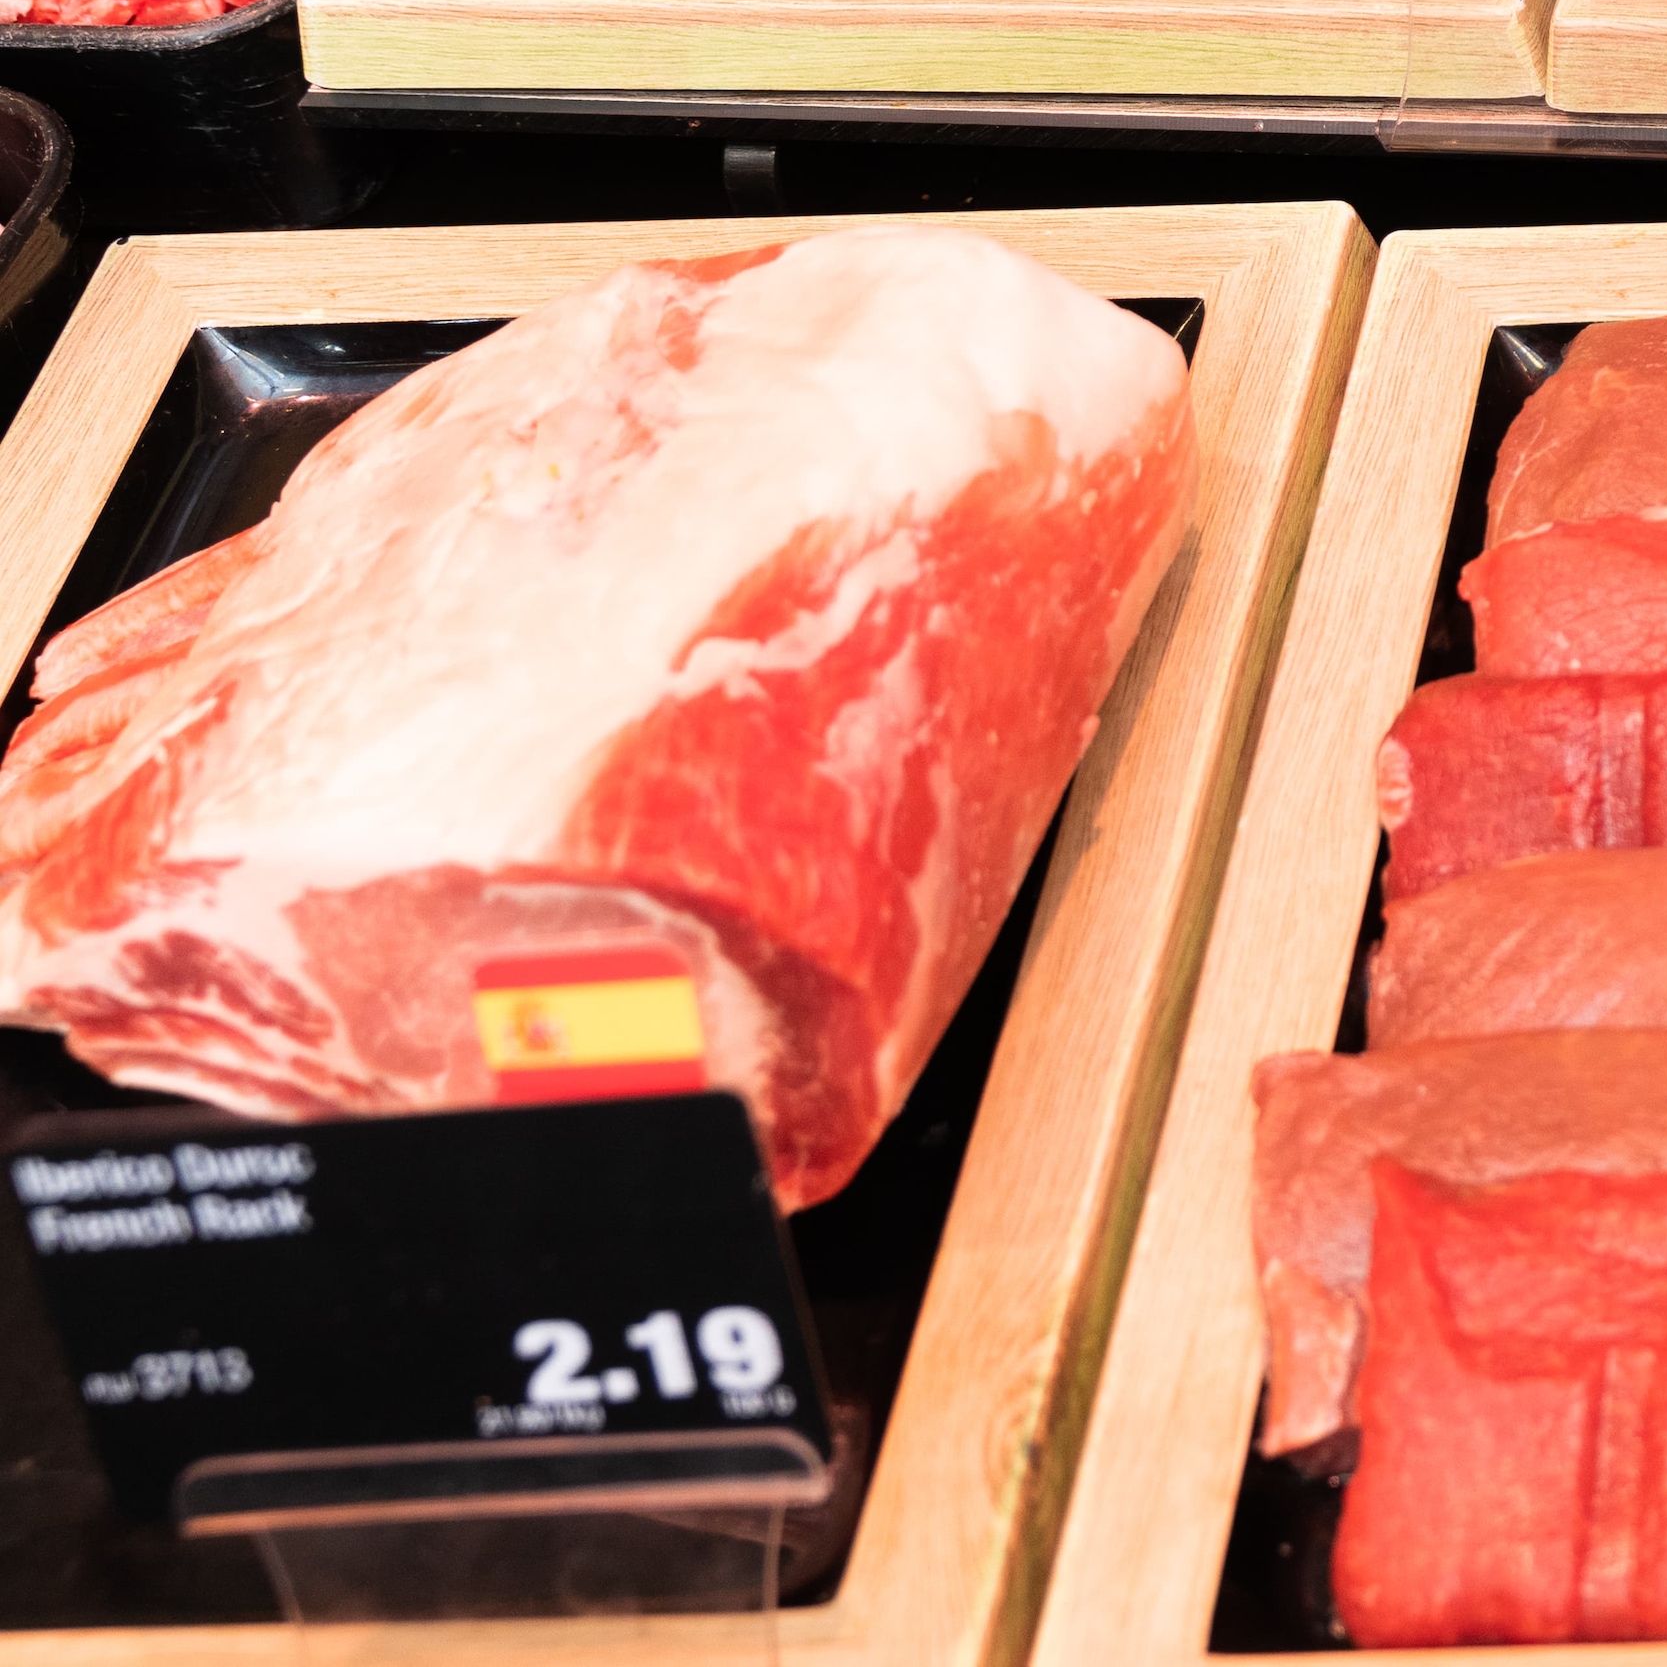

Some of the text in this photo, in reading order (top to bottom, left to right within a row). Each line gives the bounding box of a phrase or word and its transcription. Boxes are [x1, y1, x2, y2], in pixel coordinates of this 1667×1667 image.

[29, 1189, 311, 1252] French Rack
[514, 1305, 784, 1403] 2.19
